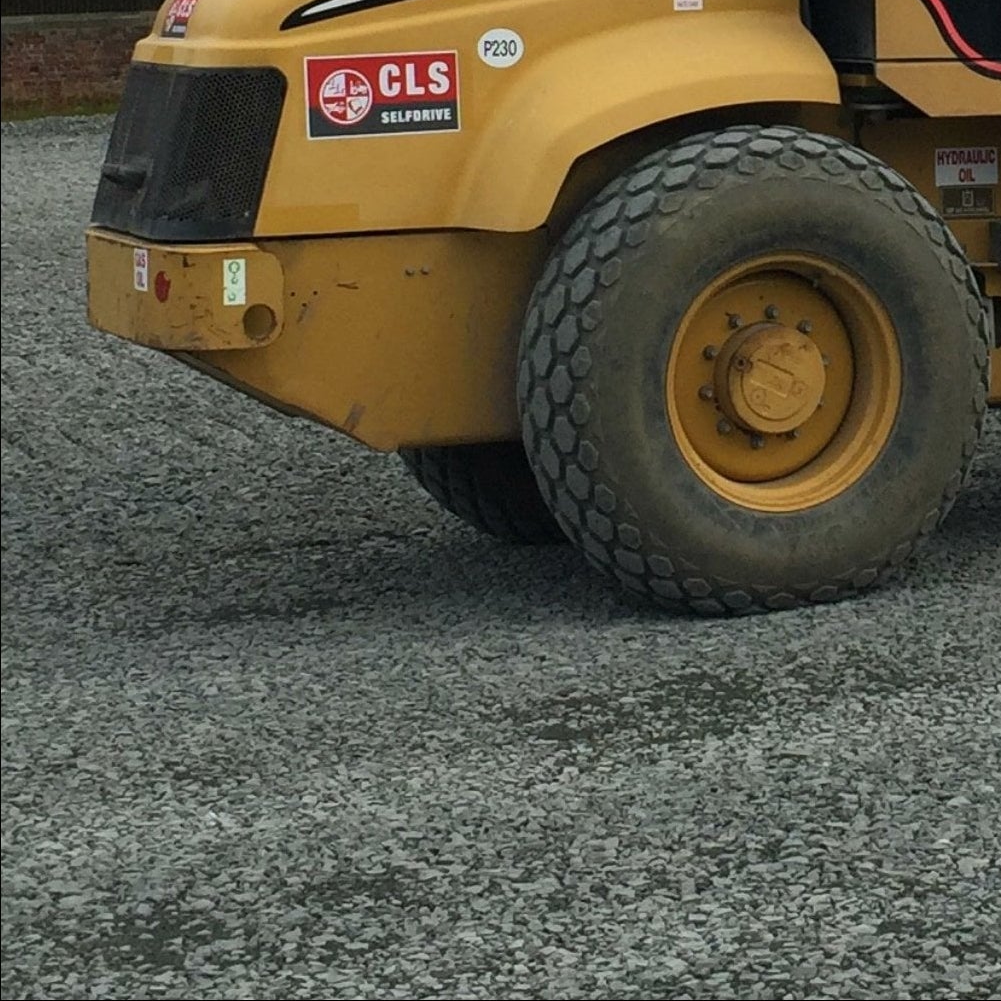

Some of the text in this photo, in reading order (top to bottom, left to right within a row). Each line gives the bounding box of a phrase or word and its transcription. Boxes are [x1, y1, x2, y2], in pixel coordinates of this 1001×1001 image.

[483, 39, 518, 57] P230
[378, 61, 451, 97] CLS
[381, 108, 452, 124] SELFDRIVE
[937, 150, 995, 166] HYDRAULIC
[958, 168, 976, 182] OIL
